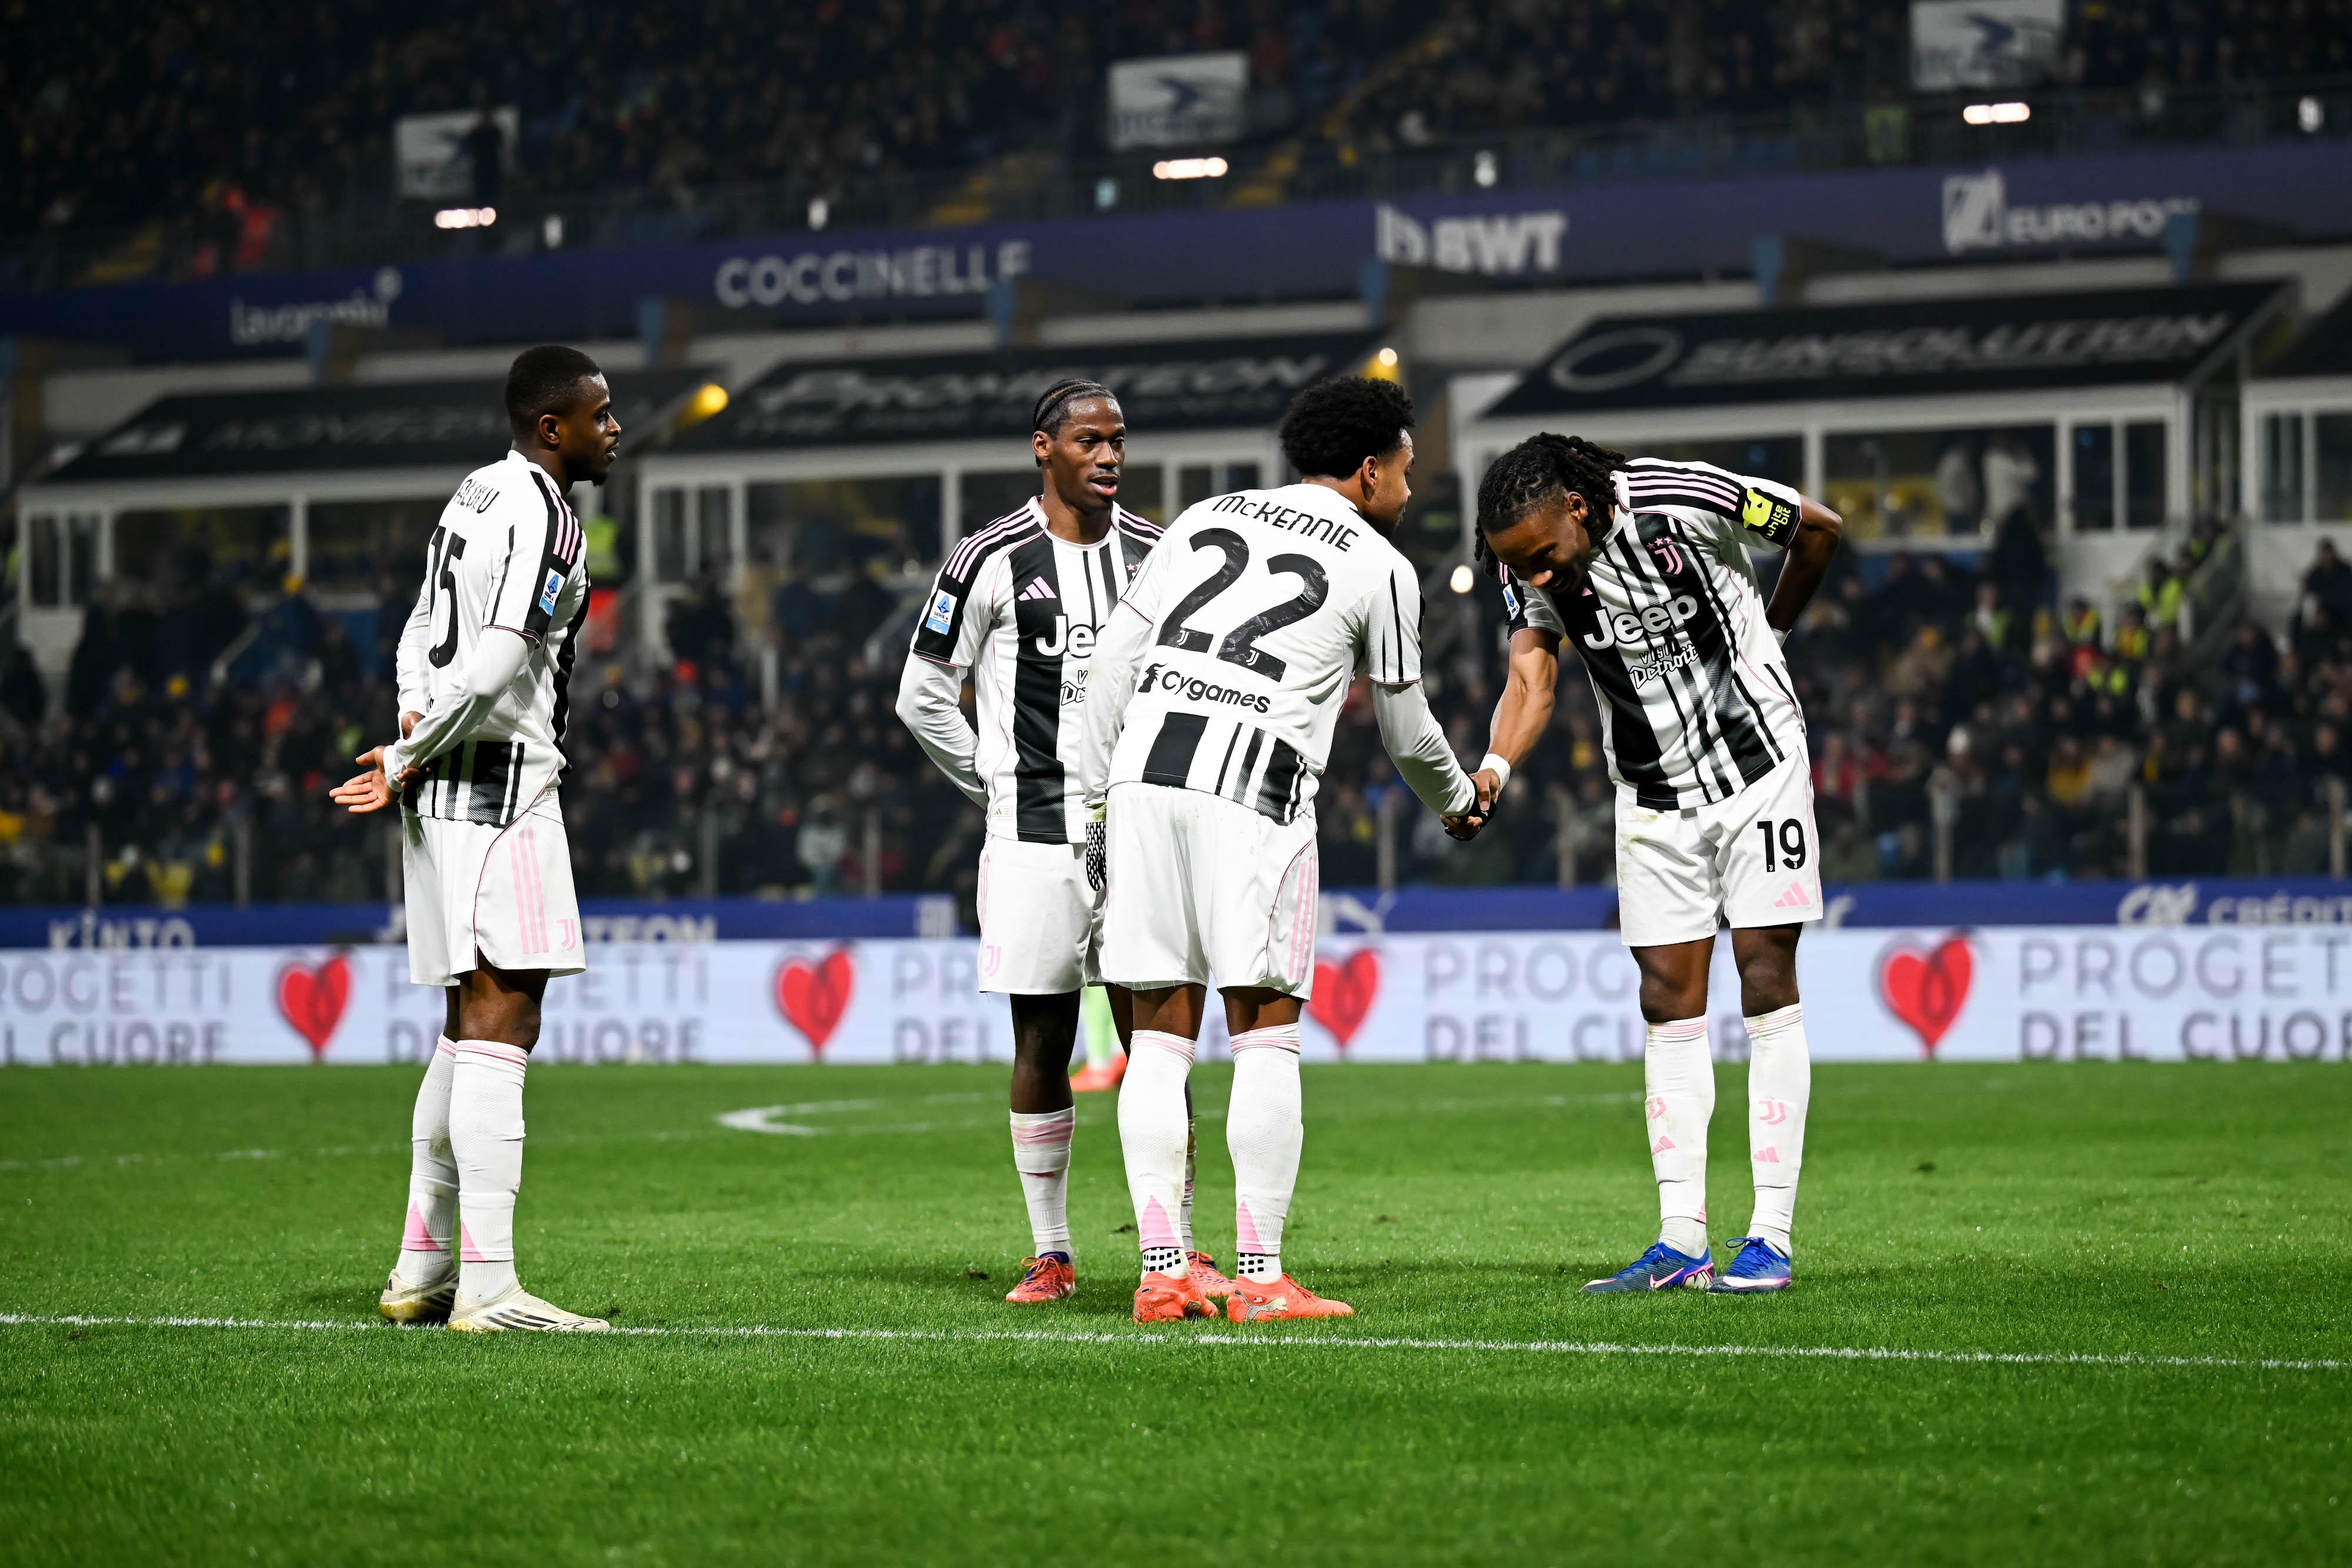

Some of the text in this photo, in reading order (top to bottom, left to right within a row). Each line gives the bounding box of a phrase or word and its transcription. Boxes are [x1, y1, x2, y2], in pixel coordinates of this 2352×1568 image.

[429, 524, 467, 669] 15
[1155, 527, 1329, 683] 22
[1034, 613, 1107, 659] Je
[1583, 594, 1699, 651] Jeep
[1629, 643, 1699, 690] Detroit
[1638, 640, 1676, 664] VISIT
[1161, 670, 1271, 714] Cygames
[1756, 817, 1806, 873] 19
[2020, 1009, 2145, 1059] DEL
